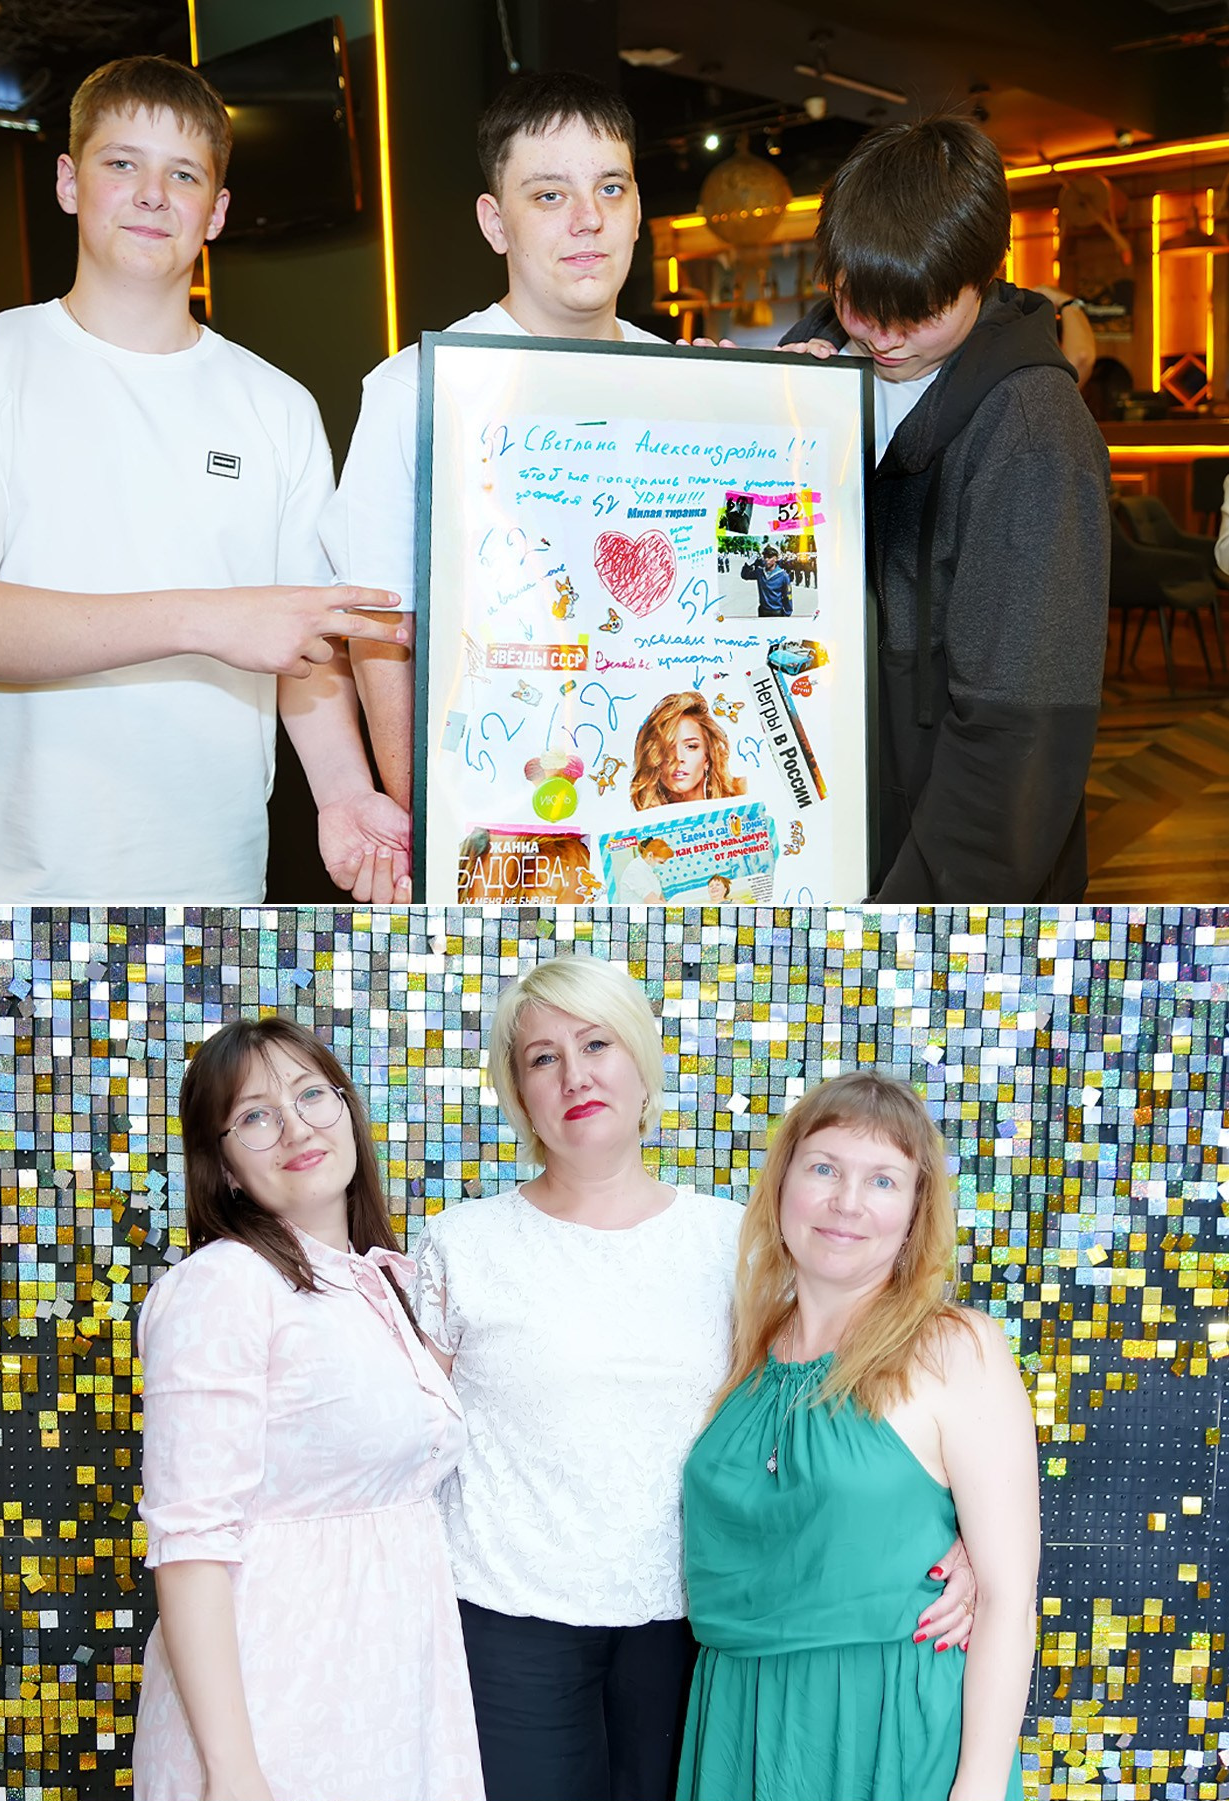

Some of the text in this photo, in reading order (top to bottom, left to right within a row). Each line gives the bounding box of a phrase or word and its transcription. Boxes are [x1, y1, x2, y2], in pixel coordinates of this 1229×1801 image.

[525, 425, 616, 452] Светлана
[627, 506, 707, 520] Милая тиранка
[778, 501, 803, 522] 52
[490, 647, 547, 669] ЗВЁЗДЫ
[550, 651, 585, 668] СССР
[753, 677, 784, 731] Негры
[781, 746, 814, 811] России
[681, 831, 706, 843] Едем
[708, 829, 714, 837] в
[490, 841, 539, 854] ЖАННА
[675, 847, 692, 857] как
[693, 842, 719, 853] взять
[714, 841, 769, 861] от лечения?
[458, 855, 570, 896] БАДОЕВА:
